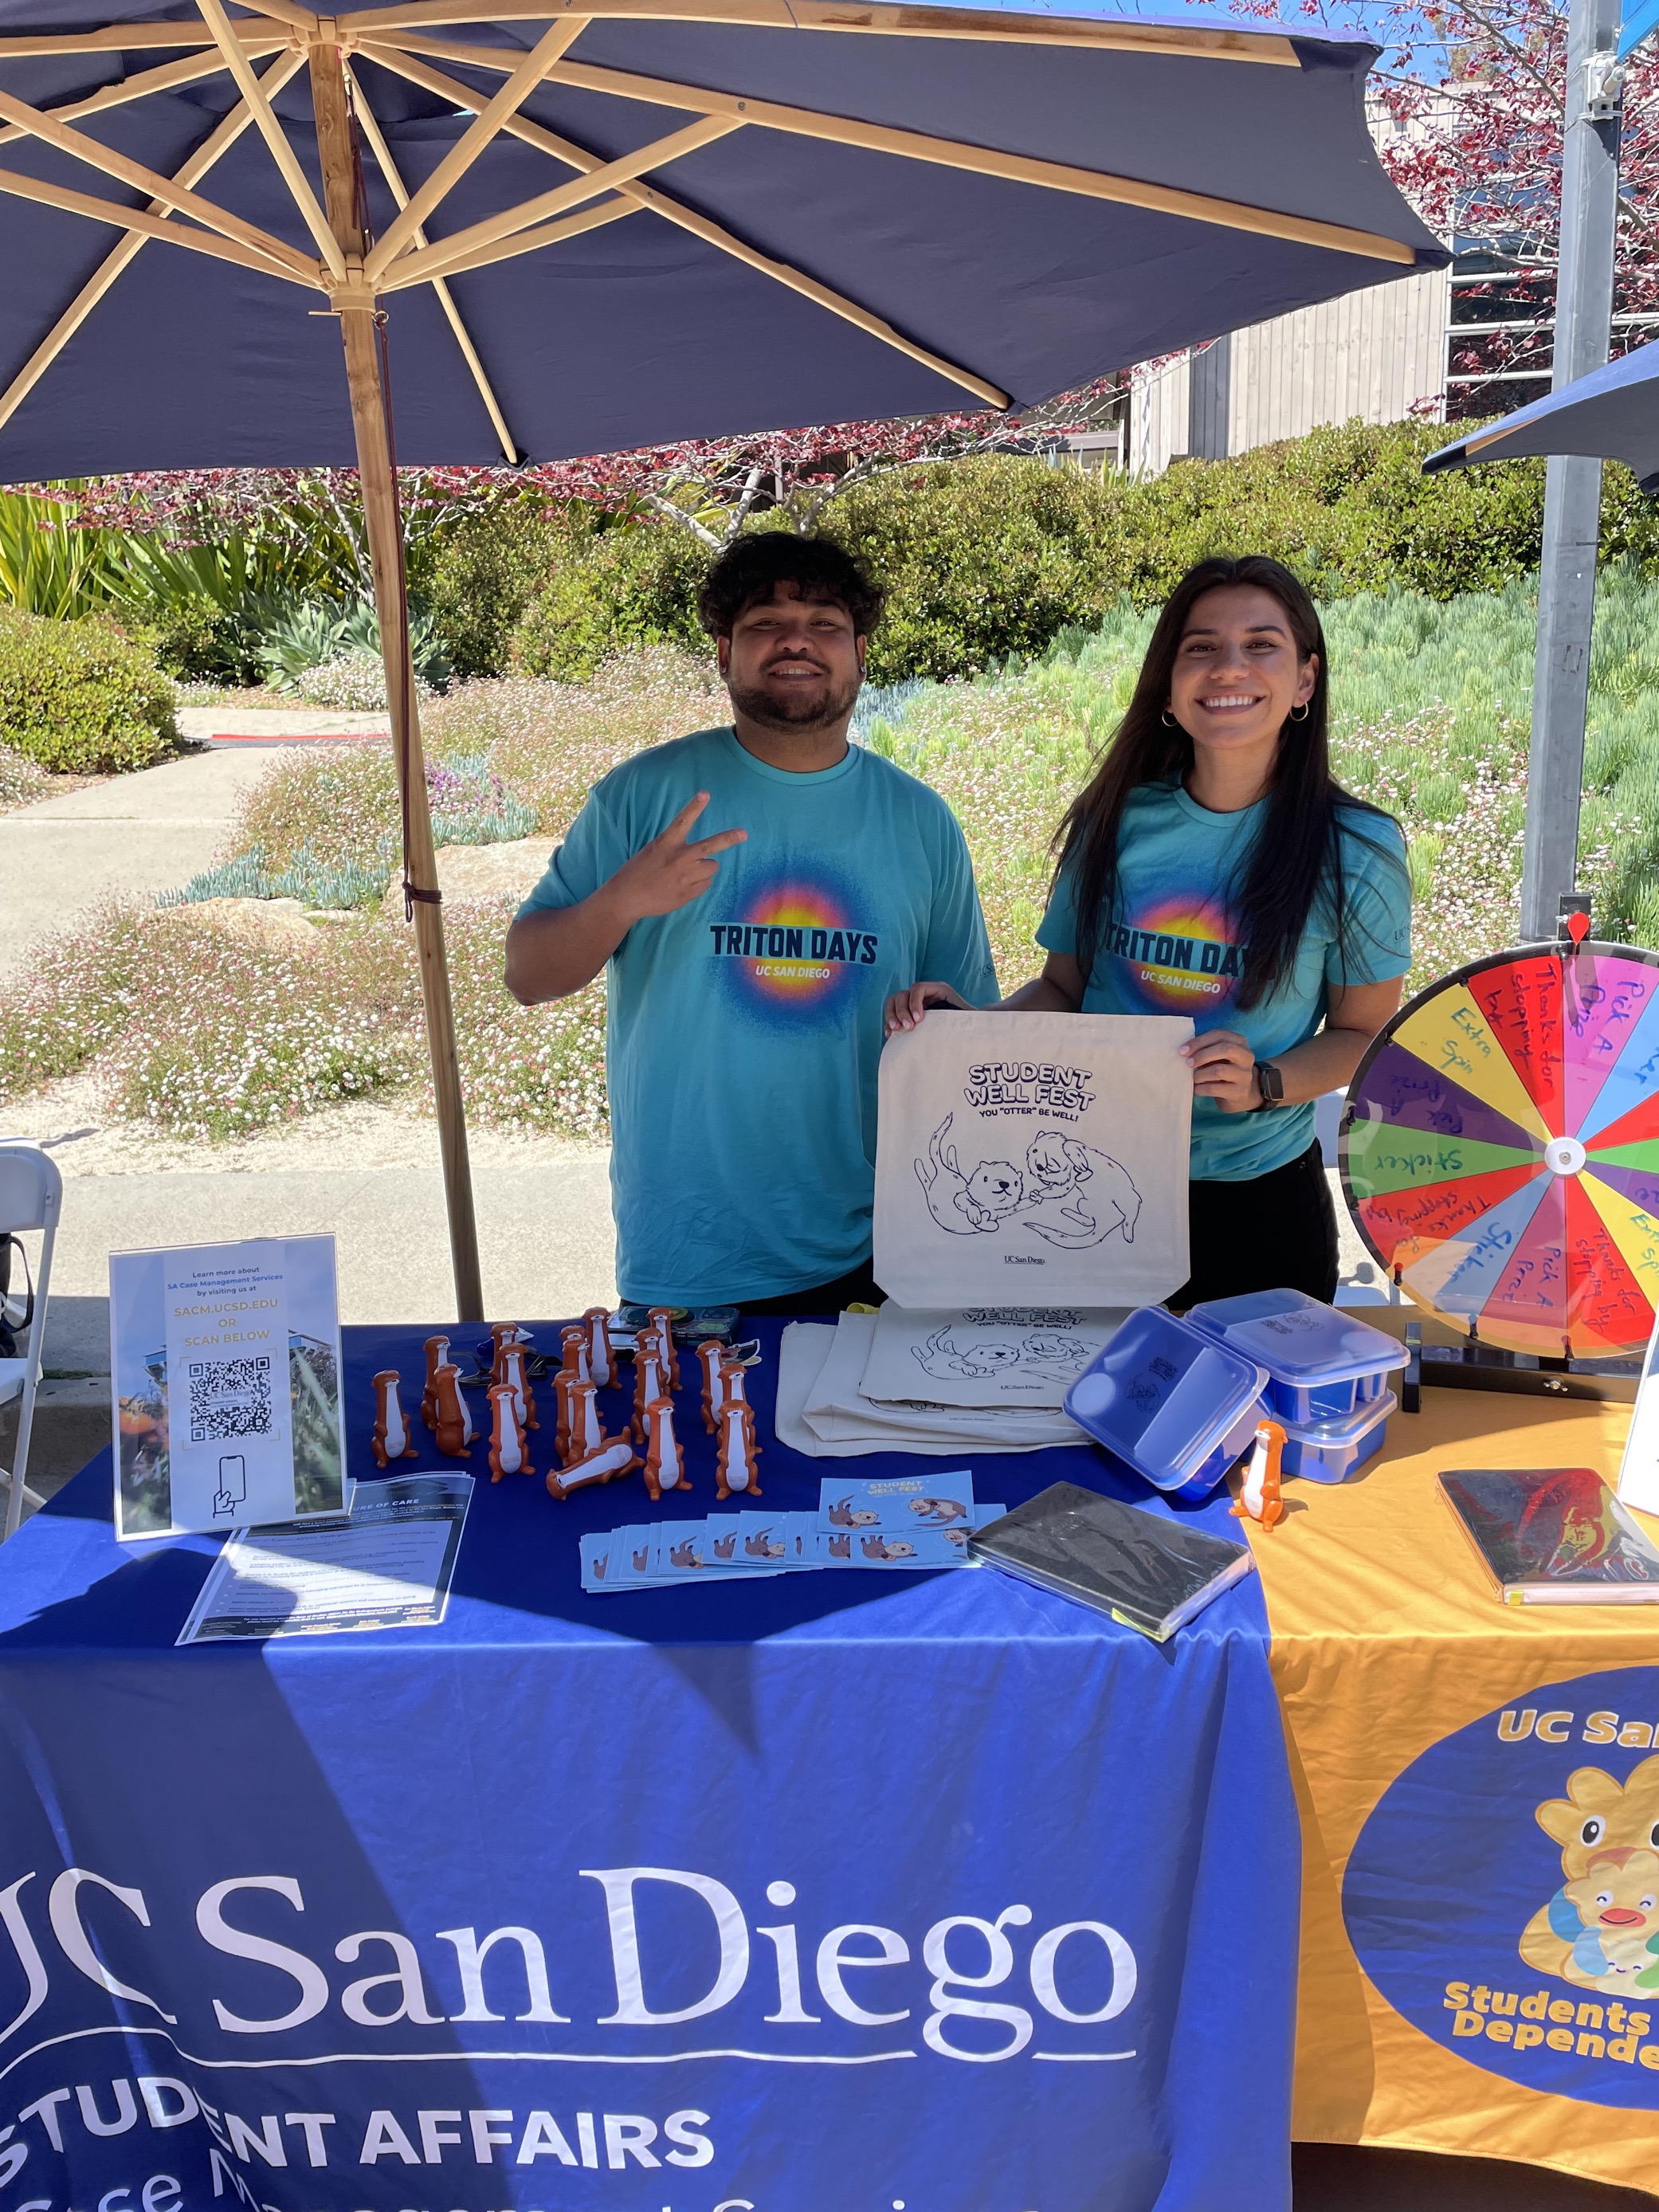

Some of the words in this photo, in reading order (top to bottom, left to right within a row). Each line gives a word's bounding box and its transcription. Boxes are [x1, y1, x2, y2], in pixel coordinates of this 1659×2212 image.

[710, 925, 803, 959] TRITON
[810, 929, 878, 965] DAYS
[755, 965, 771, 977] UC
[773, 966, 794, 978] SAN
[797, 967, 830, 979] DIEGO
[1140, 970, 1155, 982] UC
[1157, 974, 1183, 989] SAN
[1182, 979, 1222, 994] DIEGO
[1606, 981, 1645, 1026] Pick
[1451, 1006, 1492, 1058] Extra
[1440, 1040, 1473, 1075] Spin
[968, 1061, 1093, 1090] STUDENT
[963, 1084, 1030, 1108] WELL
[1035, 1084, 1096, 1112] FEST
[979, 1108, 998, 1118] YOU
[1052, 1110, 1079, 1122] WELL!
[1027, 1256, 1045, 1265] Diego
[200, 1277, 250, 1287] Management
[209, 1287, 237, 1296] visiting
[174, 1299, 279, 1316] SACM.UCSD.EDU
[963, 1312, 1024, 1322] WELL
[1030, 1313, 1088, 1325] FEST
[218, 1318, 237, 1328] OR
[185, 1335, 219, 1347] SCAN
[224, 1330, 269, 1343] BELOW
[869, 1481, 923, 1489] STUDENT
[1497, 1709, 1573, 1743] UC
[195, 1875, 571, 2034] San
[578, 1867, 1137, 2063] Diego
[1443, 1982, 1651, 2036] Students
[359, 2110, 715, 2169] AFFAIRS
